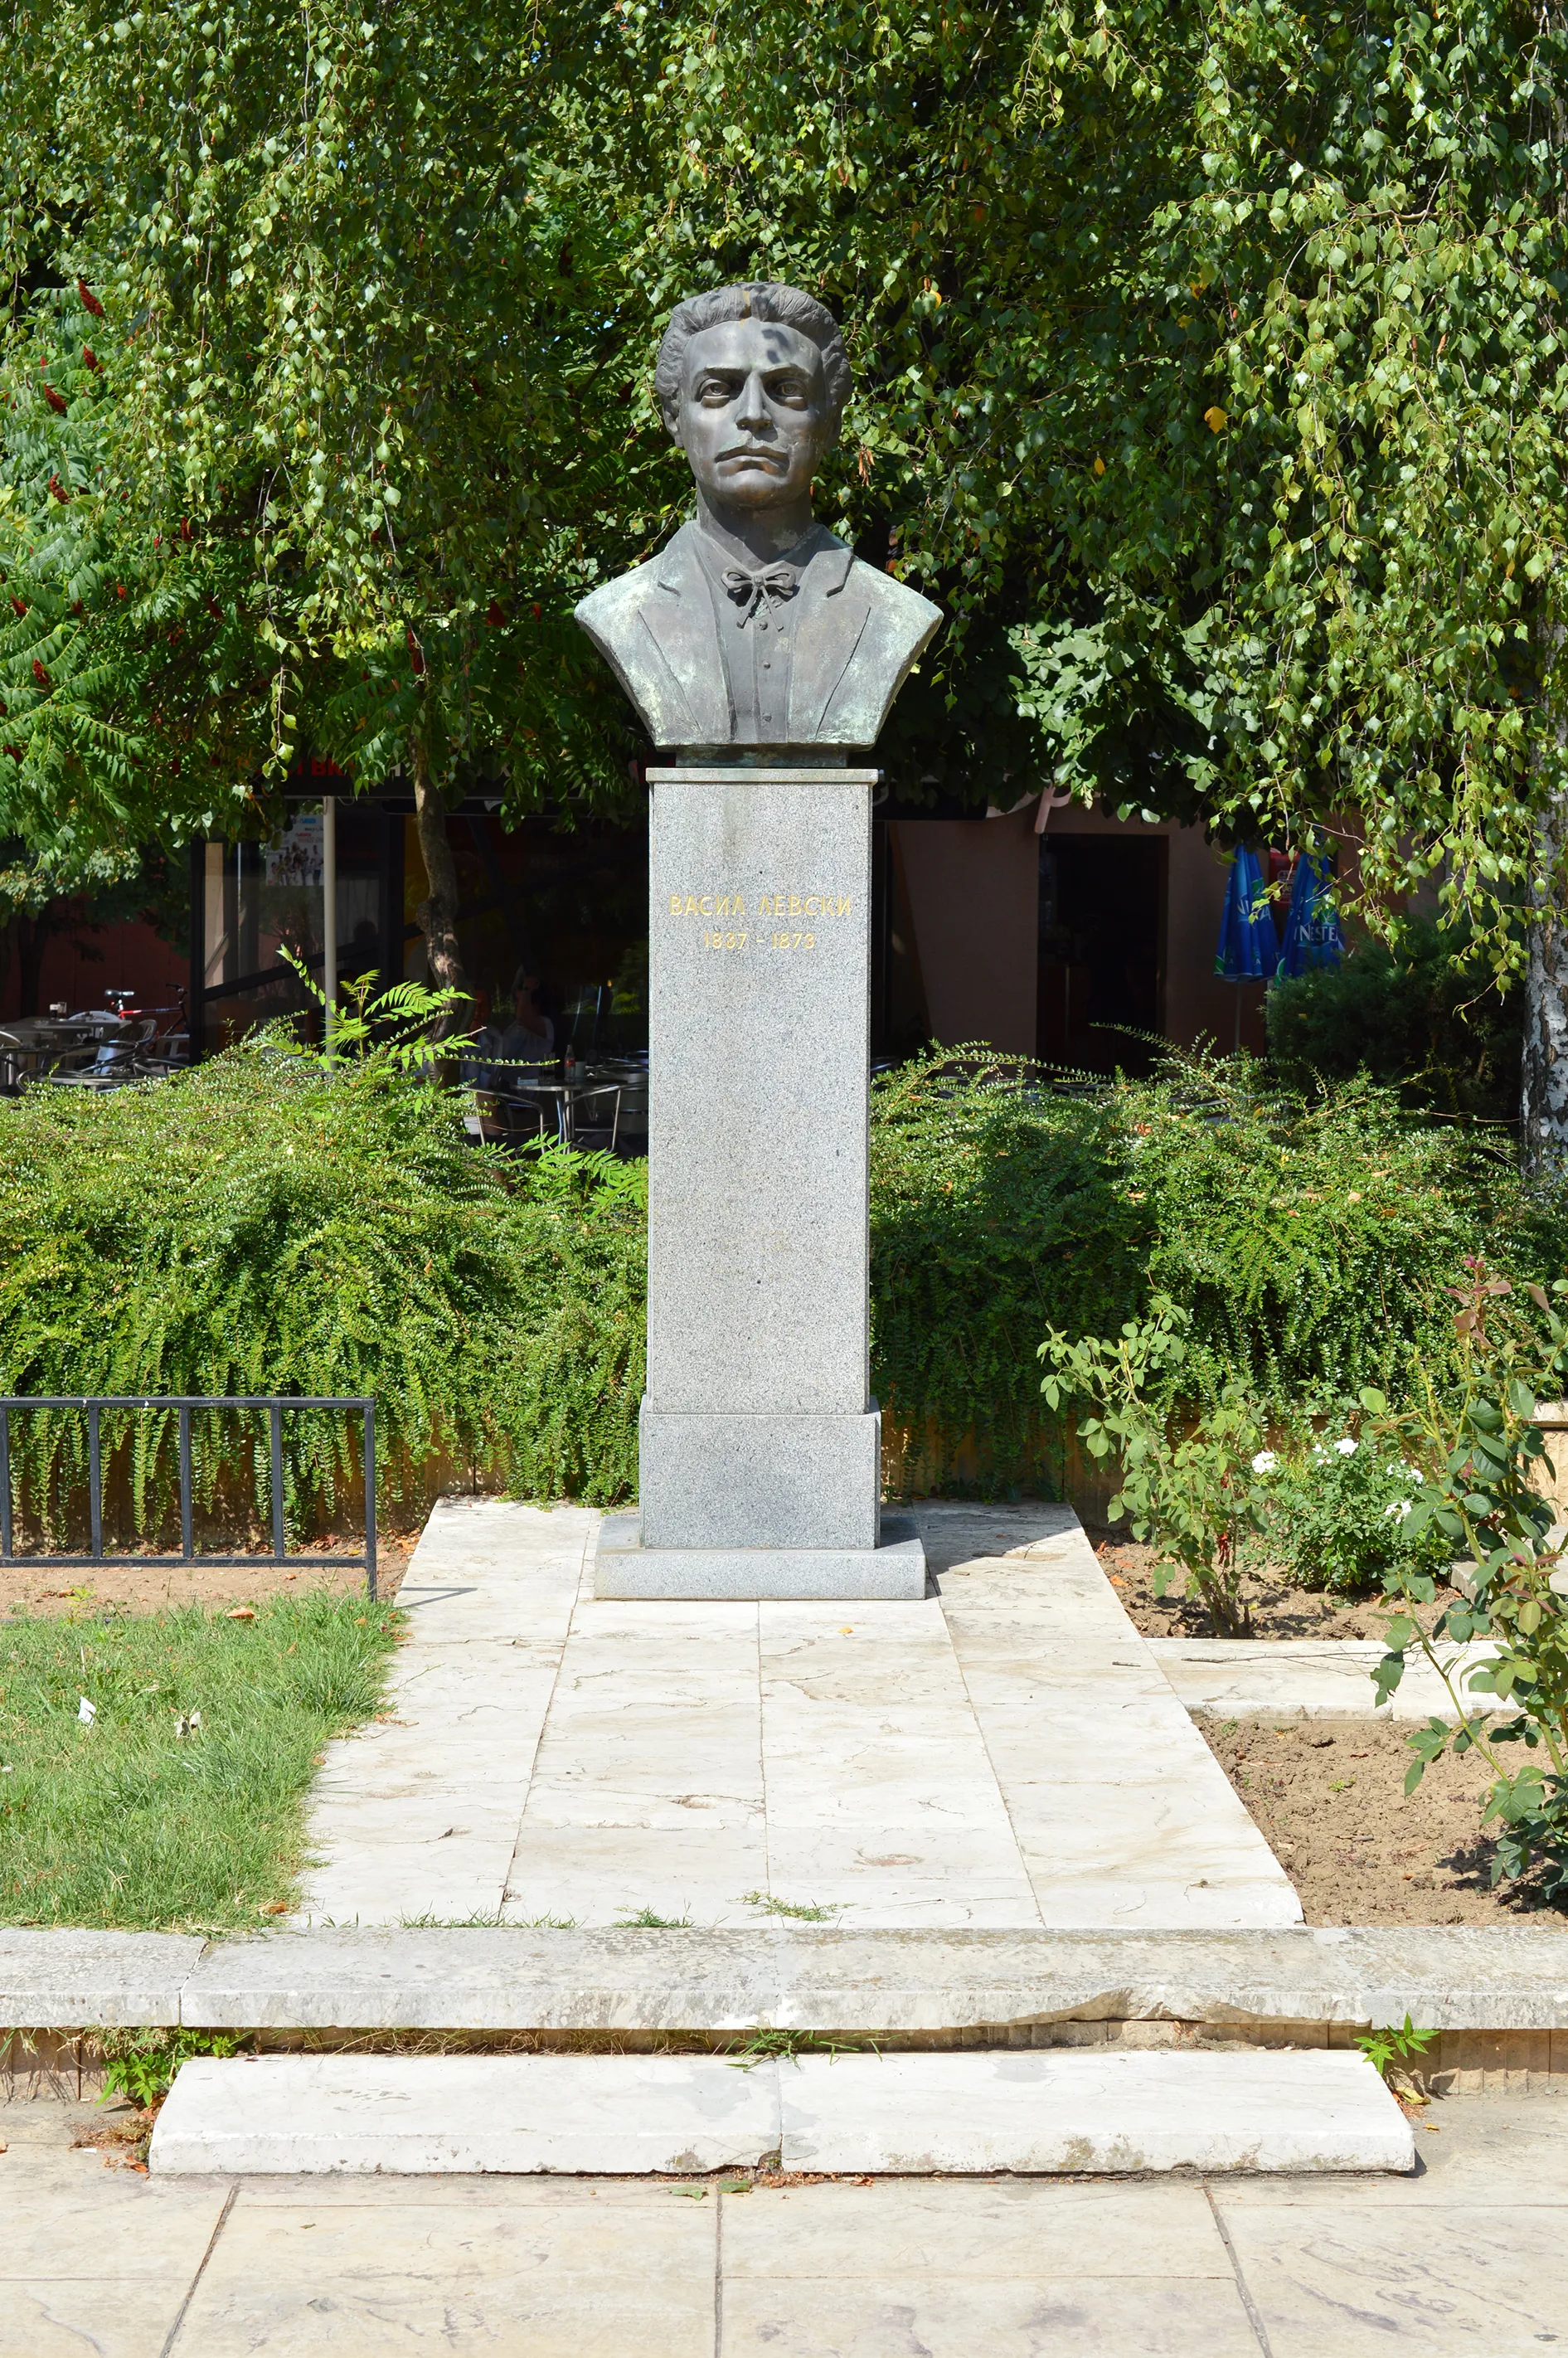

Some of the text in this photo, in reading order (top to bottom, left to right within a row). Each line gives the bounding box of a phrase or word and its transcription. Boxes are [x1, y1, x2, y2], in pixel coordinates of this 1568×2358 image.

[669, 895, 852, 916] ВАСИЛ ЛЕВСКИ
[705, 931, 747, 949] 1837
[772, 931, 815, 949] 1873
[1299, 924, 1338, 942] NESTE
